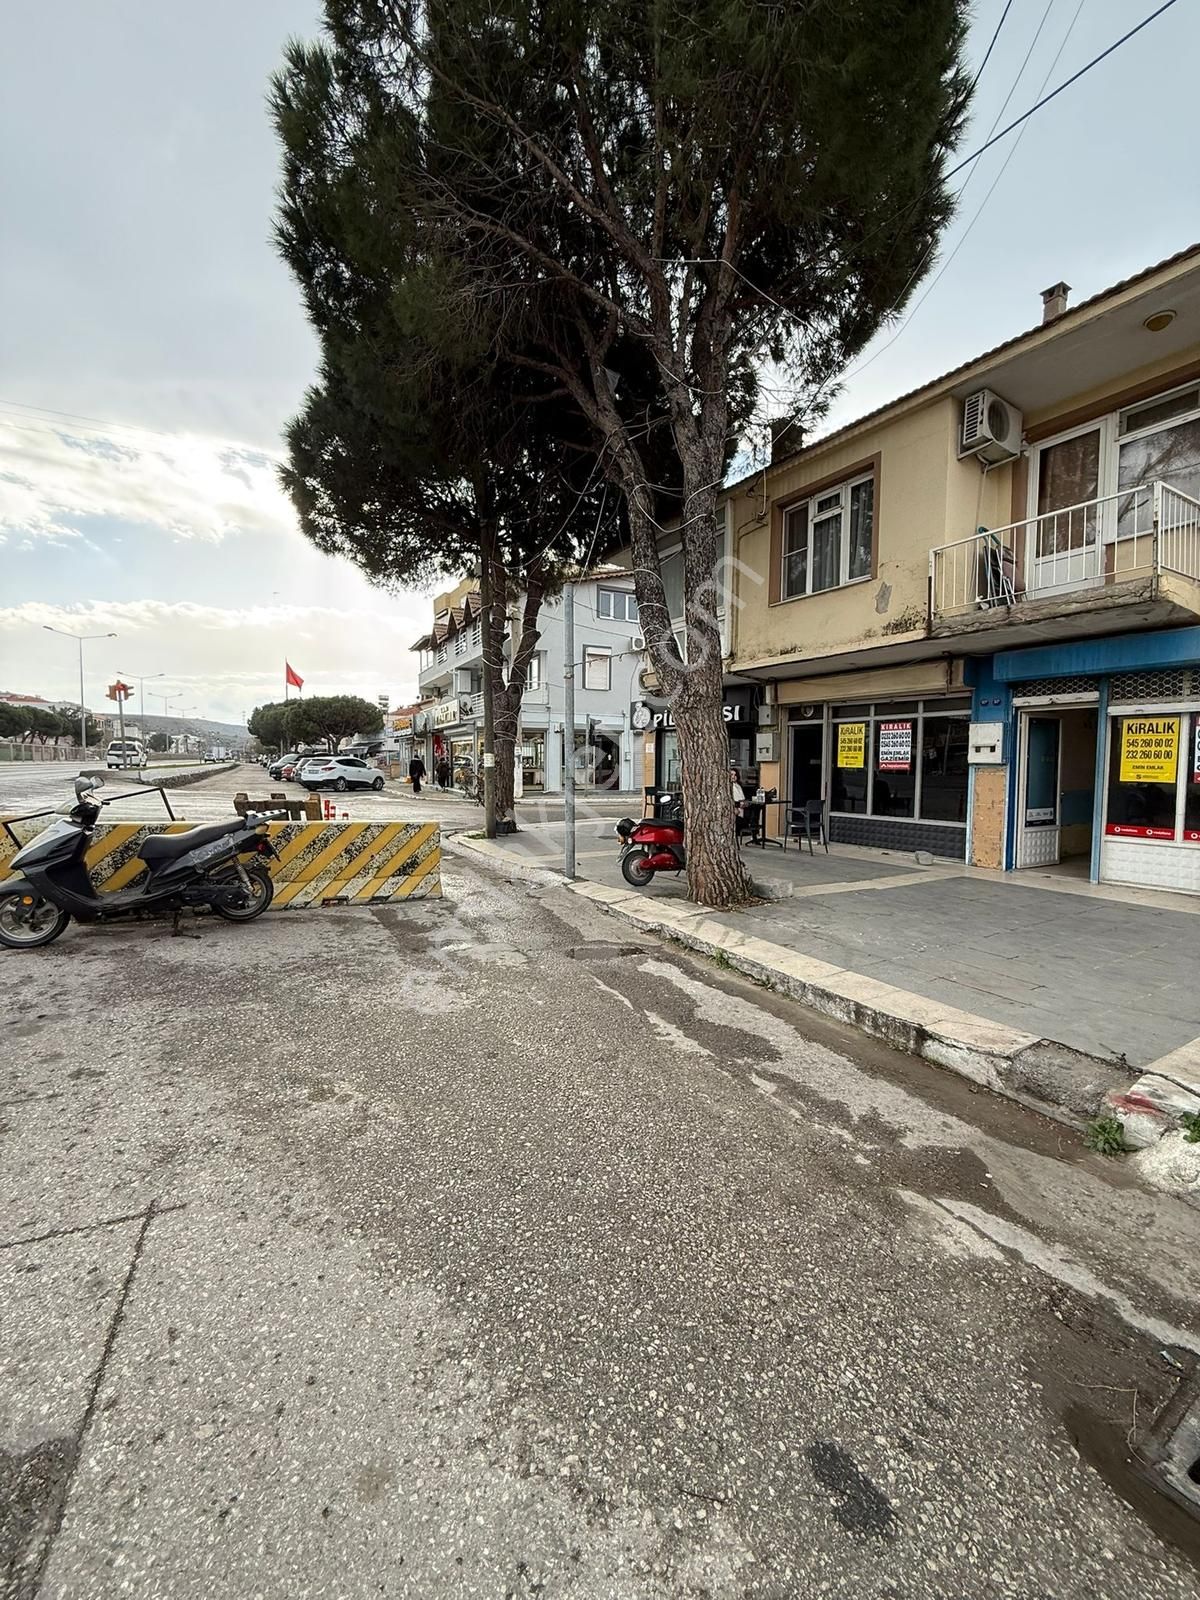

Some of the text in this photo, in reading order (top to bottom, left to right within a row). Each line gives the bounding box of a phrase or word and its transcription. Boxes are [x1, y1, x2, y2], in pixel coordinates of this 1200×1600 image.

[1126, 738, 1173, 748] 545 260 60 02
[1126, 750, 1172, 759] 232 260 60 00
